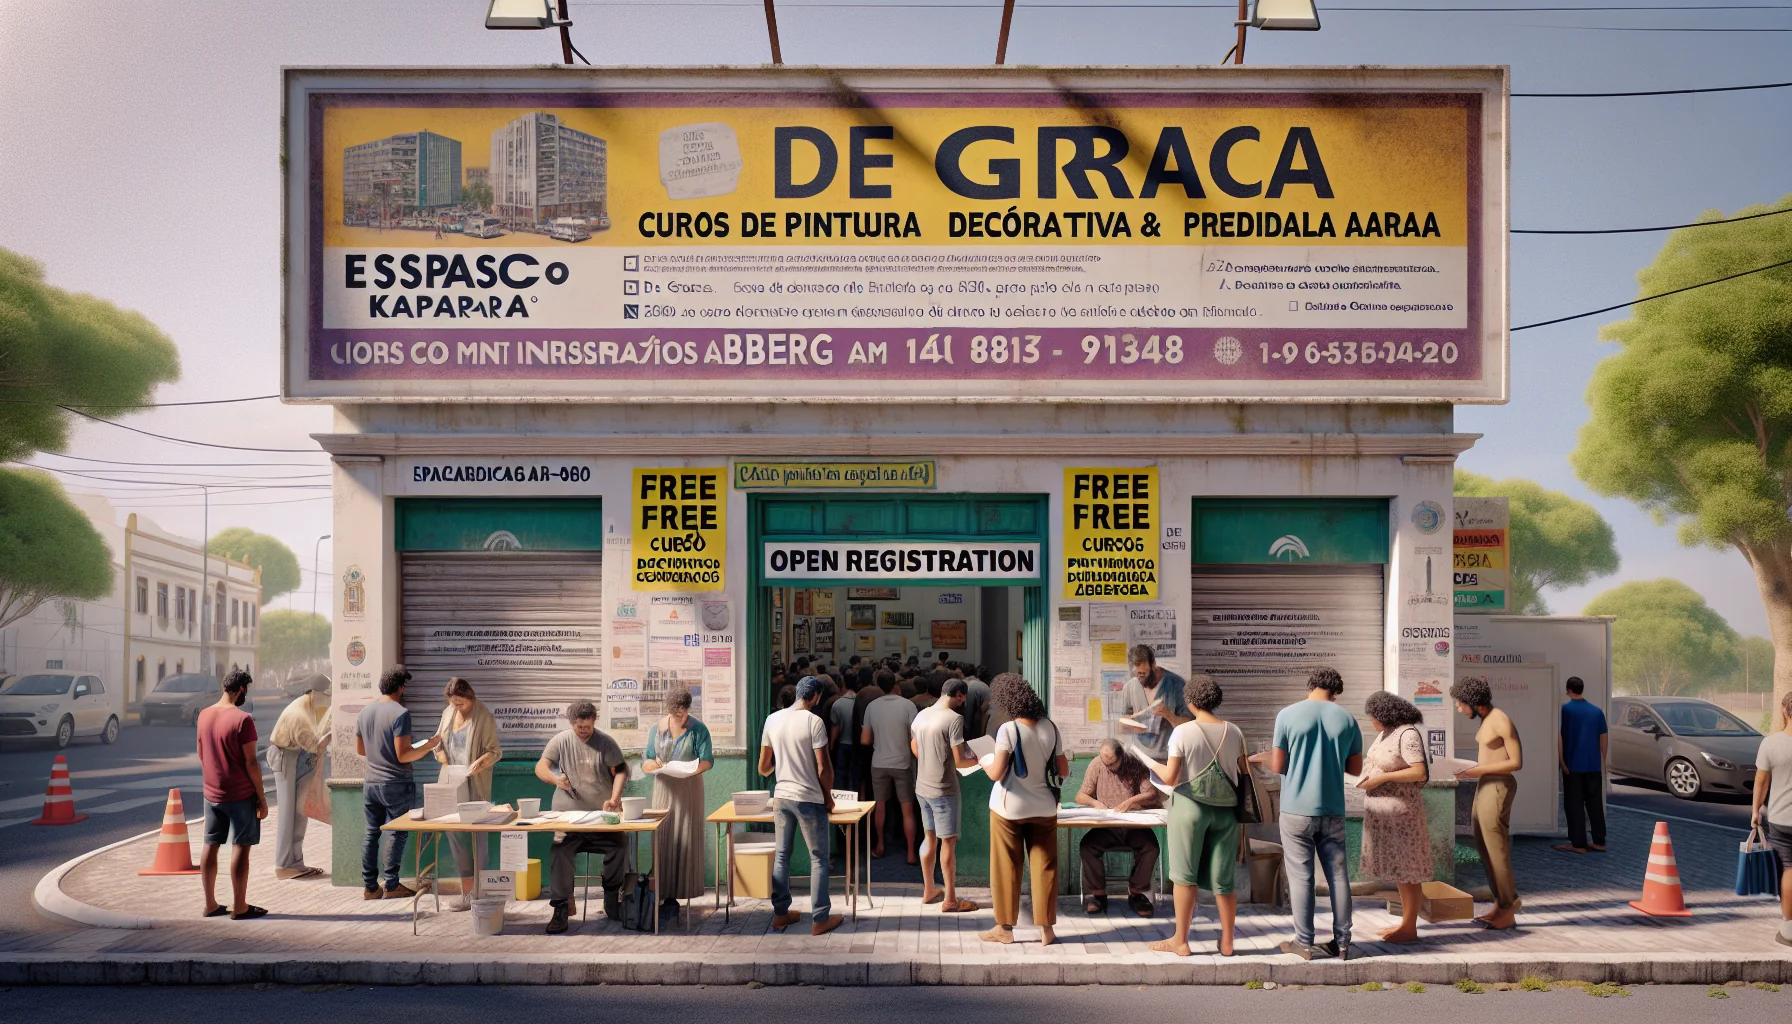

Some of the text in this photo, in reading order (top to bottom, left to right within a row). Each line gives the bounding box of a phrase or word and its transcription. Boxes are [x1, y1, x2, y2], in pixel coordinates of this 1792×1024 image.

[774, 126, 894, 199] DE
[638, 211, 730, 238] CUROS
[741, 211, 776, 238] DE
[949, 206, 1132, 238] DECÓRATIVA
[1140, 211, 1161, 238] &
[1184, 211, 1336, 238] PREDIDALA
[1345, 211, 1441, 238] AARAA
[847, 340, 888, 366] AM
[970, 334, 1042, 365] 8813
[1080, 334, 1185, 365] 91348
[641, 474, 717, 500] FREE
[1073, 474, 1149, 499] FREE
[642, 504, 718, 530] FREE
[1073, 503, 1150, 530] FREE
[770, 549, 1034, 572] OPEN REGISTRATION
